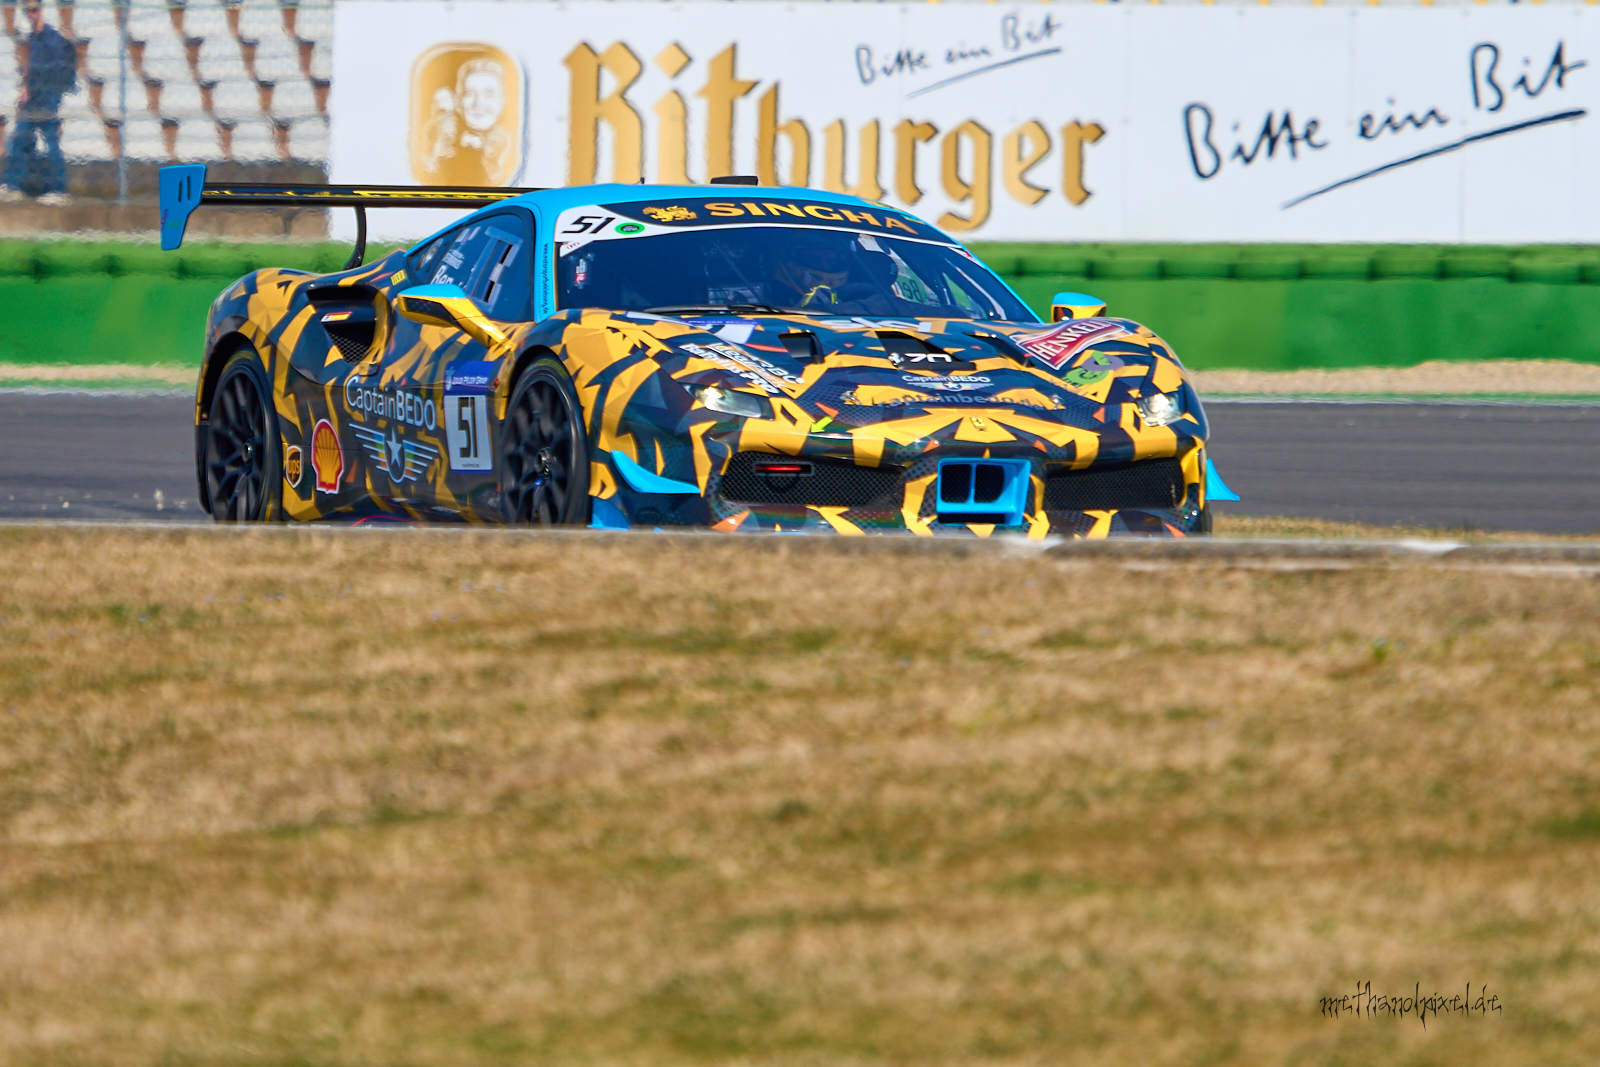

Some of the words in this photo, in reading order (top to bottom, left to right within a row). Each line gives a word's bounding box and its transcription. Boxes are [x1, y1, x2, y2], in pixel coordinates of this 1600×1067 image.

[854, 43, 932, 86] Bitte
[944, 39, 992, 65] ein
[1001, 12, 1064, 52] Bit
[562, 40, 1106, 232] Bitburger
[1182, 101, 1330, 180] Bitte
[1357, 95, 1450, 141] ein
[1468, 38, 1589, 113] Bit
[560, 215, 617, 235] 51
[703, 202, 919, 235] SINGHA
[345, 375, 437, 431] CaptainBEDO
[901, 375, 992, 383] CaptainBEDO
[457, 396, 479, 459] 51
